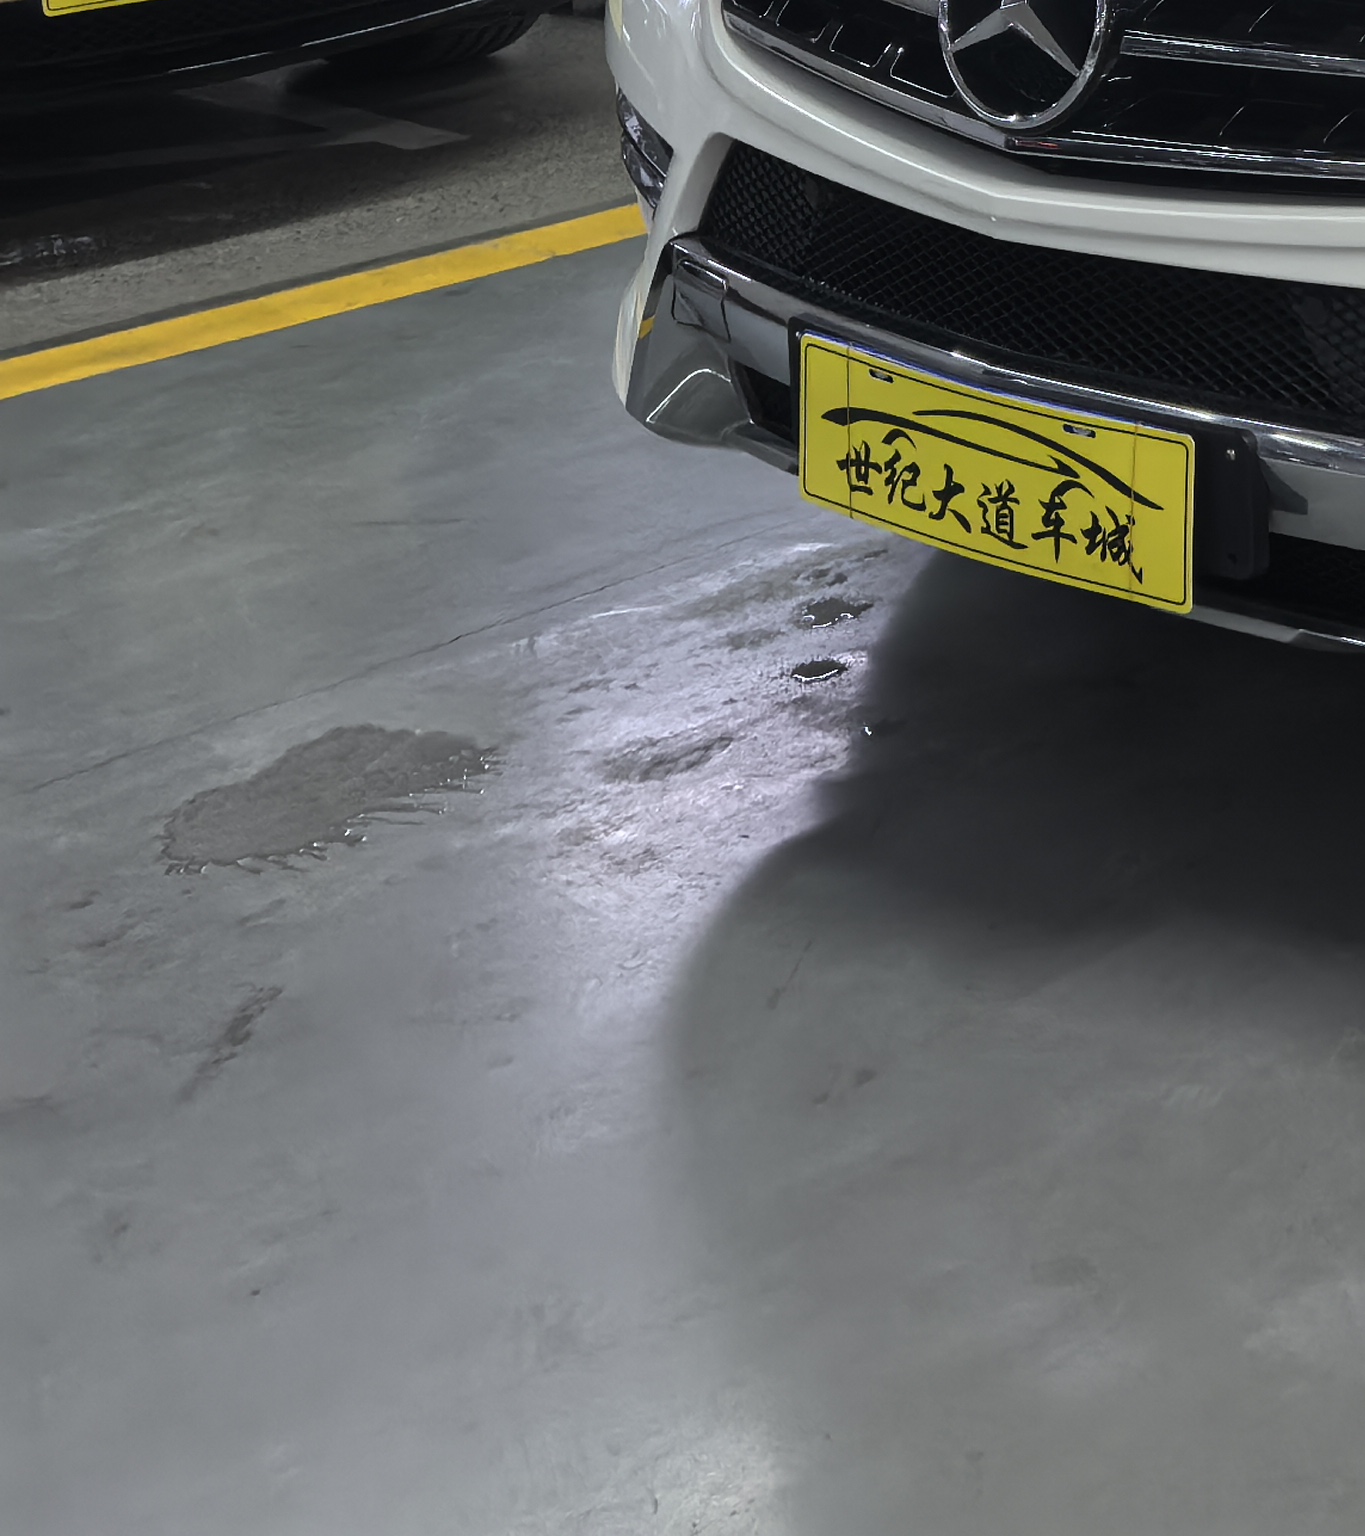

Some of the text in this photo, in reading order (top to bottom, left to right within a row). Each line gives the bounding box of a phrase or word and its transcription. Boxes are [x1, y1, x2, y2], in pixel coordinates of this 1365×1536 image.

[836, 434, 1144, 585] 世纪大道车城
